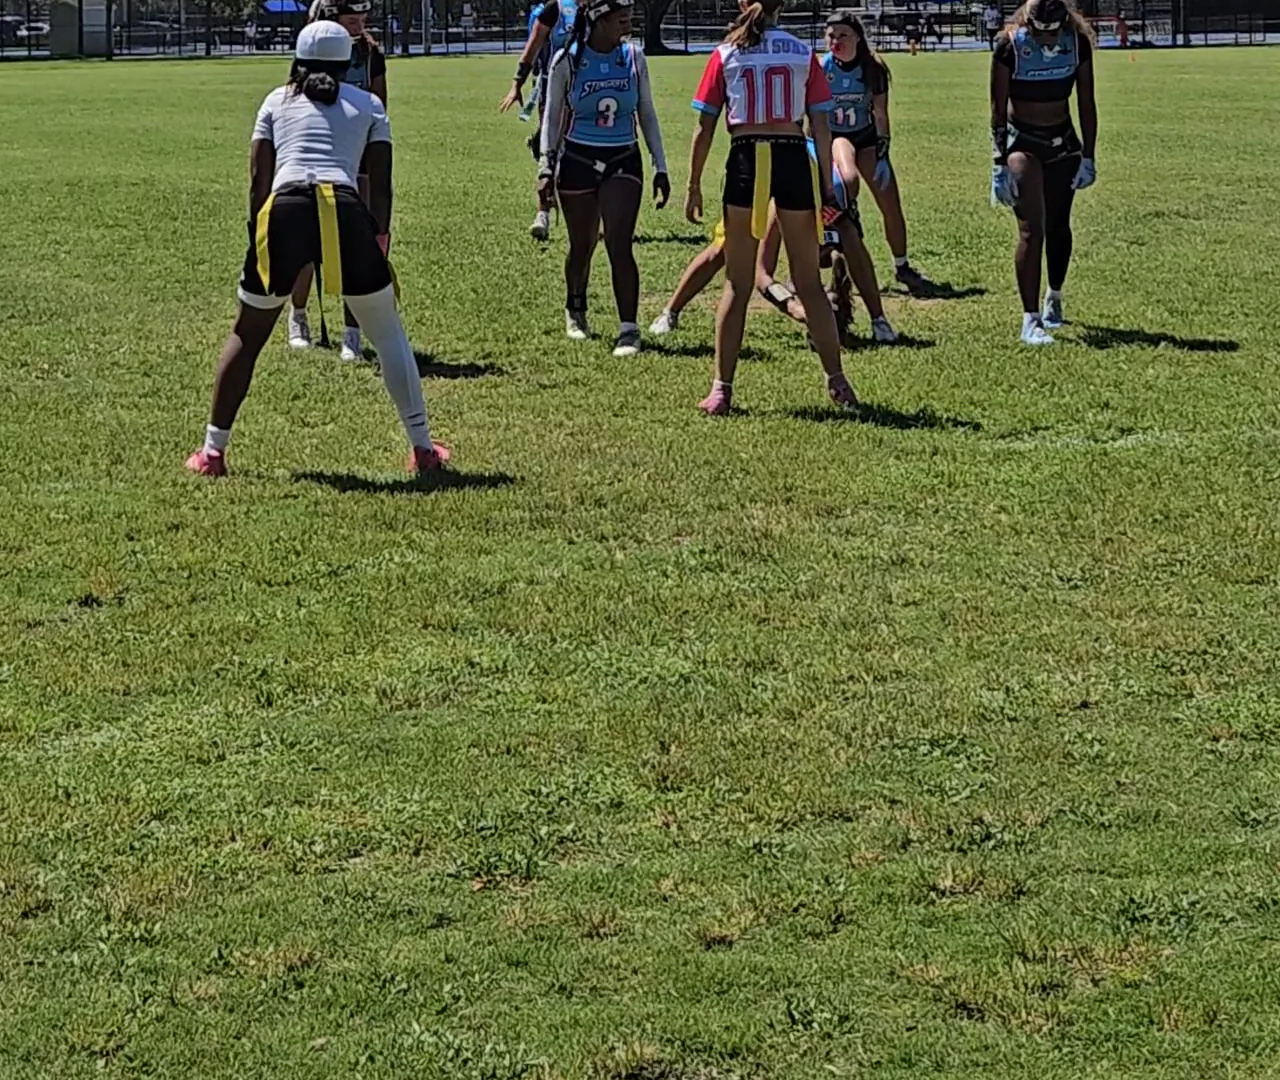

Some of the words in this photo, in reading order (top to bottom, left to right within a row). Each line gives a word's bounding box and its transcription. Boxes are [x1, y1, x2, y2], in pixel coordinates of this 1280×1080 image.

[741, 64, 793, 124] 10
[596, 97, 618, 128] 3
[834, 107, 856, 126] 11
